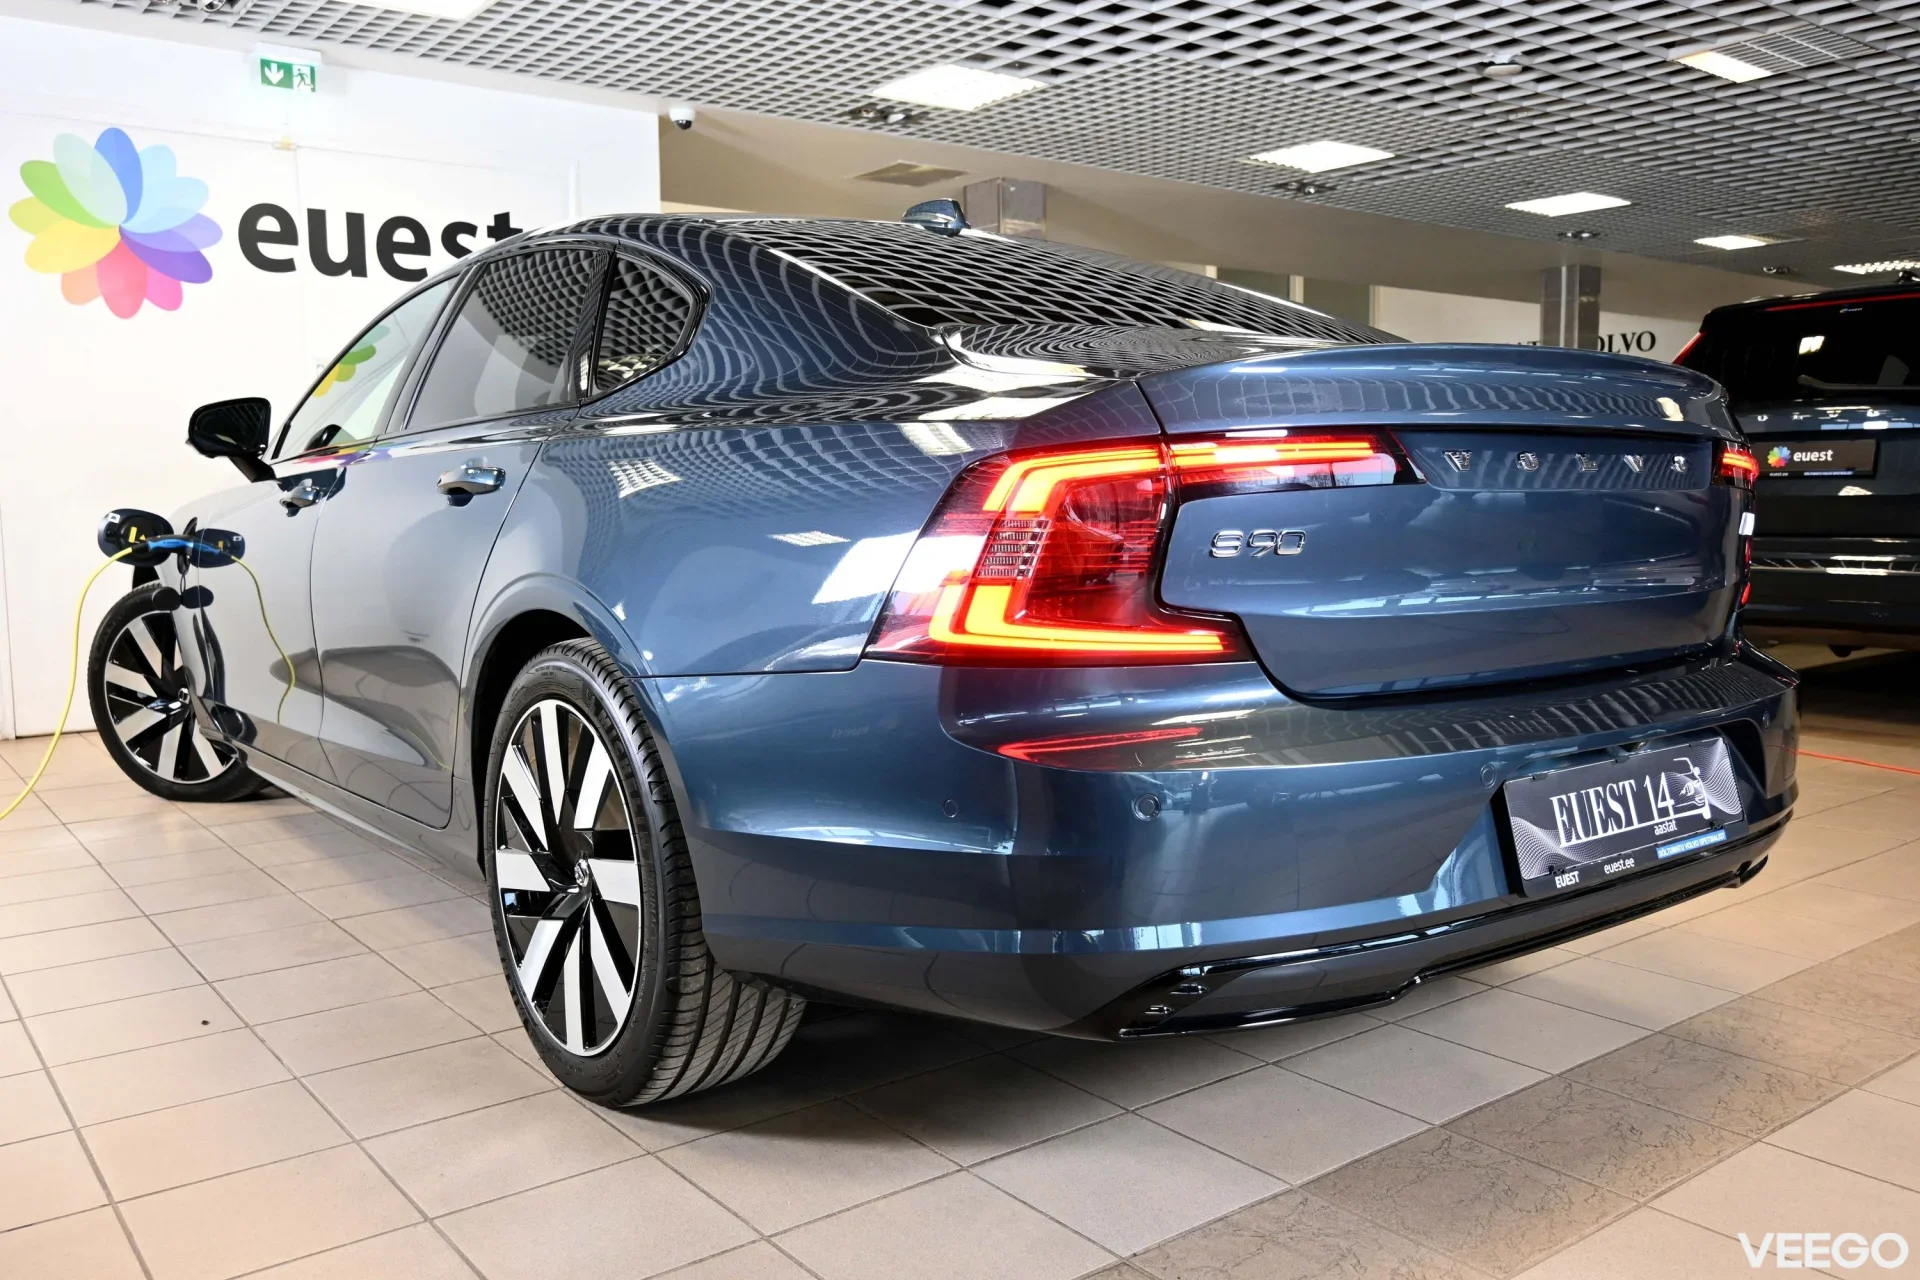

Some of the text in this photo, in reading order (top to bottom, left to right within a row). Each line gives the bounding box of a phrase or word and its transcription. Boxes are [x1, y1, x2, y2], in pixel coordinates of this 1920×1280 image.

[1793, 449, 1834, 461] euest
[1210, 529, 1306, 558] S90
[1550, 772, 1675, 848] EUEST 14
[1654, 819, 1678, 835] aastat
[1684, 840, 1700, 852] VOLVO
[1604, 857, 1635, 874] euest.ee
[1555, 871, 1580, 888] EUEST
